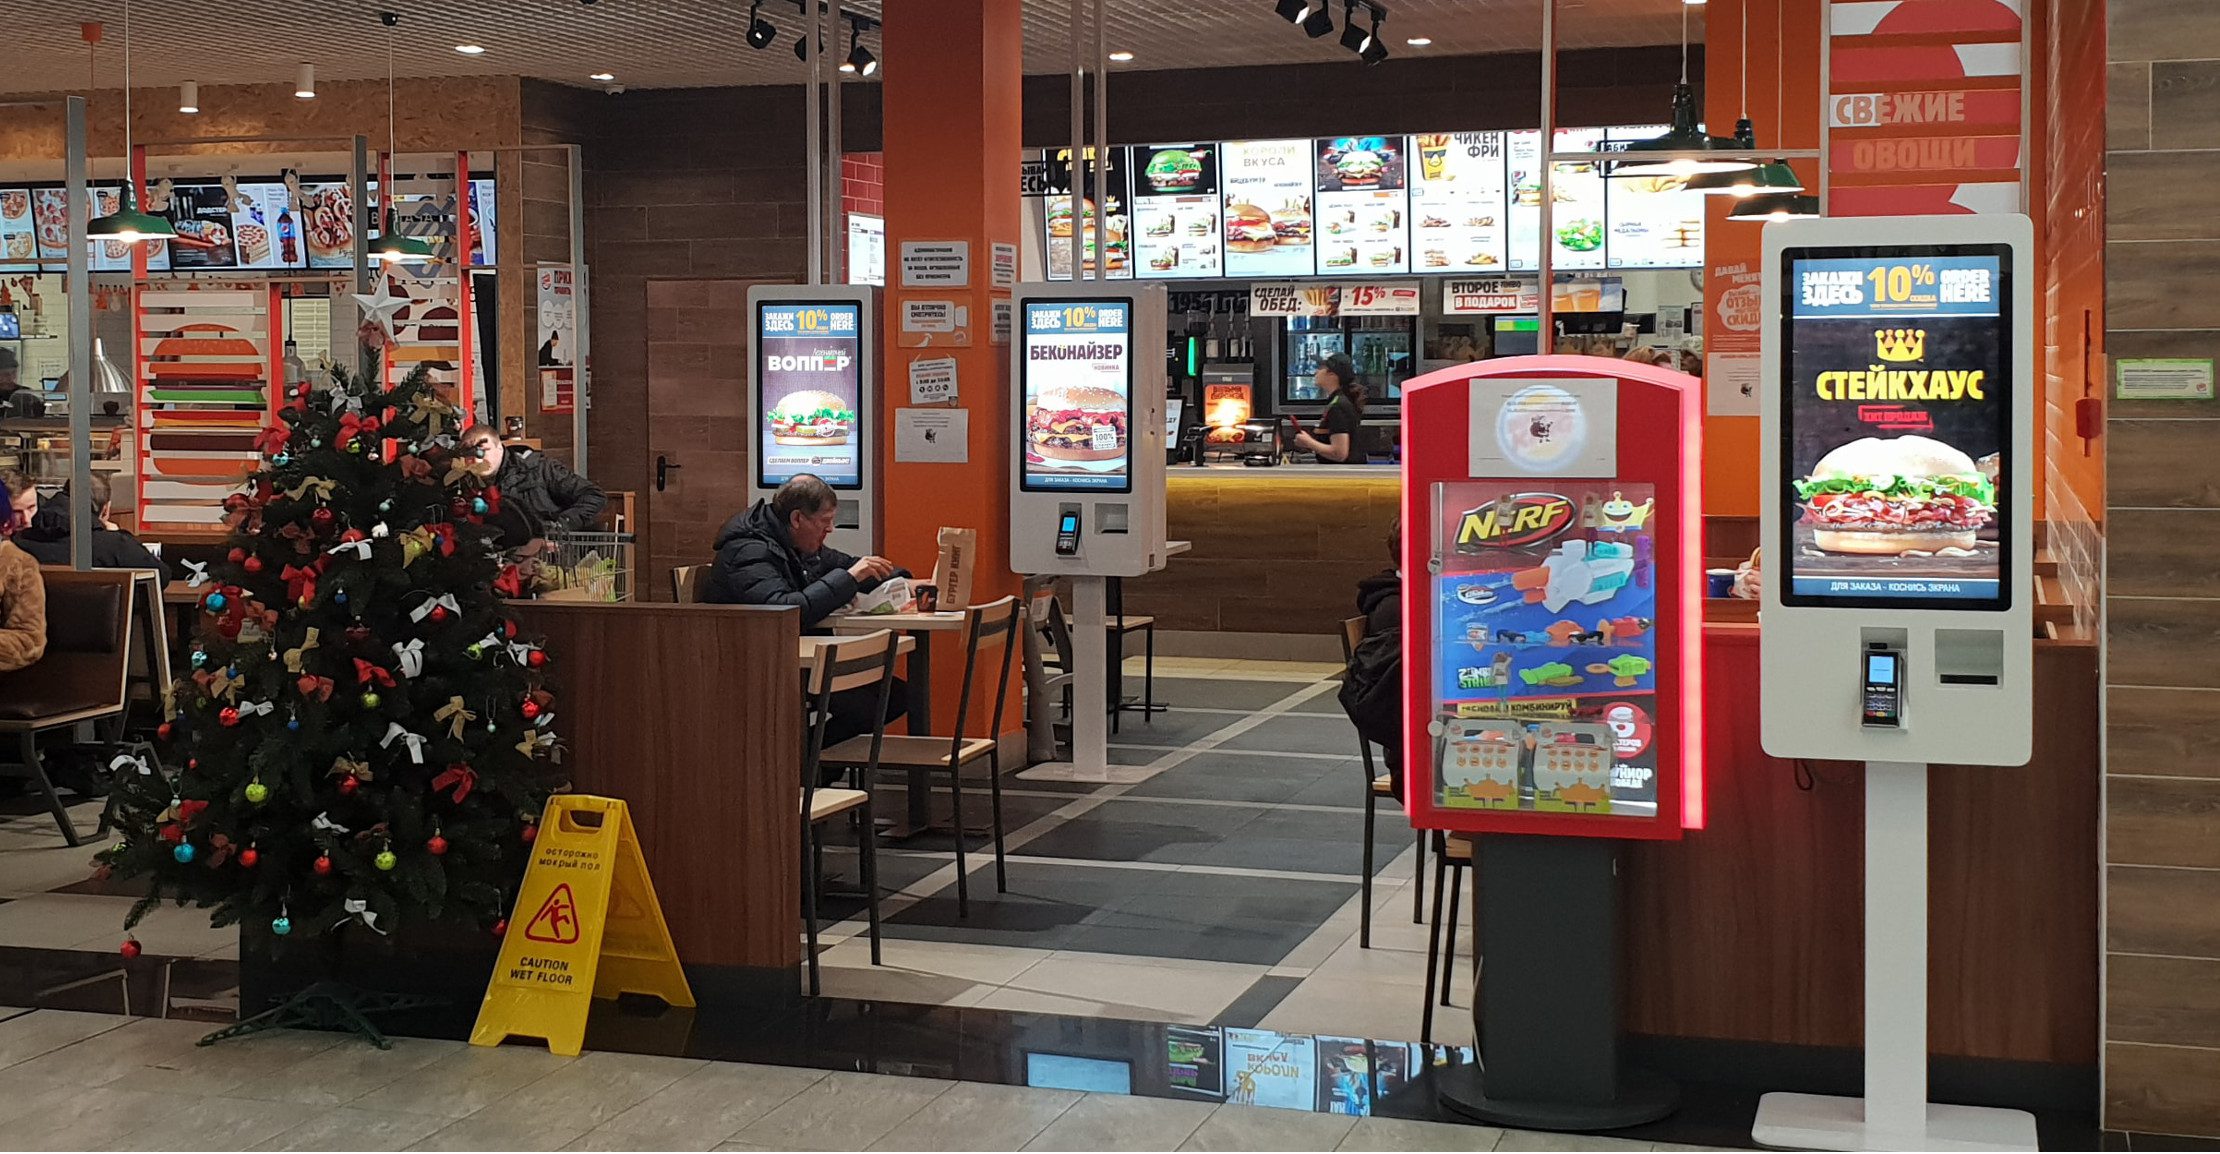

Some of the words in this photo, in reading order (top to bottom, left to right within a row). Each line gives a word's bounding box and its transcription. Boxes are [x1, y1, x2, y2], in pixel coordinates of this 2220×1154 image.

[1836, 92, 1965, 124] СВЕЖИЕ
[1454, 133, 1499, 145] ЧИКЕН
[1467, 145, 1499, 158] ФРИ
[1244, 157, 1285, 167] ВКУСА
[1802, 271, 1863, 285] ЗАКАЖИ
[1867, 264, 1935, 302] 10%
[1940, 269, 1990, 284] ORDER
[1254, 285, 1295, 299] СДЕЛАЙ
[1452, 281, 1499, 294] ВТОРОЕ
[1940, 284, 1991, 303] HERE
[1455, 296, 1463, 308] В
[1464, 296, 1516, 308] ПОДАРОК
[1802, 285, 1864, 306] ЗДЕСЬ
[1260, 298, 1302, 312] ОБЕД:
[797, 309, 828, 331] 10%
[830, 312, 854, 320] ORDER
[1063, 307, 1096, 328] 10%
[1098, 309, 1123, 318] ORDER
[765, 320, 794, 332] ЗДЕСЬ
[830, 320, 854, 331] HERE
[1098, 317, 1123, 327] HERE
[1816, 364, 1984, 400] СТЕЙКХАУС
[1094, 433, 1115, 441] 100%
[950, 545, 961, 569] КИНГ
[946, 571, 958, 604] БУРГЕР
[1830, 582, 1848, 591] ДЛЯ
[1850, 582, 1882, 591] ЗАКАЗА
[1888, 583, 1926, 592] КОСНИСЬ
[1928, 583, 1960, 593] ЭКРАНА
[580, 862, 600, 870] пол
[520, 956, 569, 971] CAUTION
[510, 969, 533, 980] WET
[537, 971, 573, 985] FLOOR
